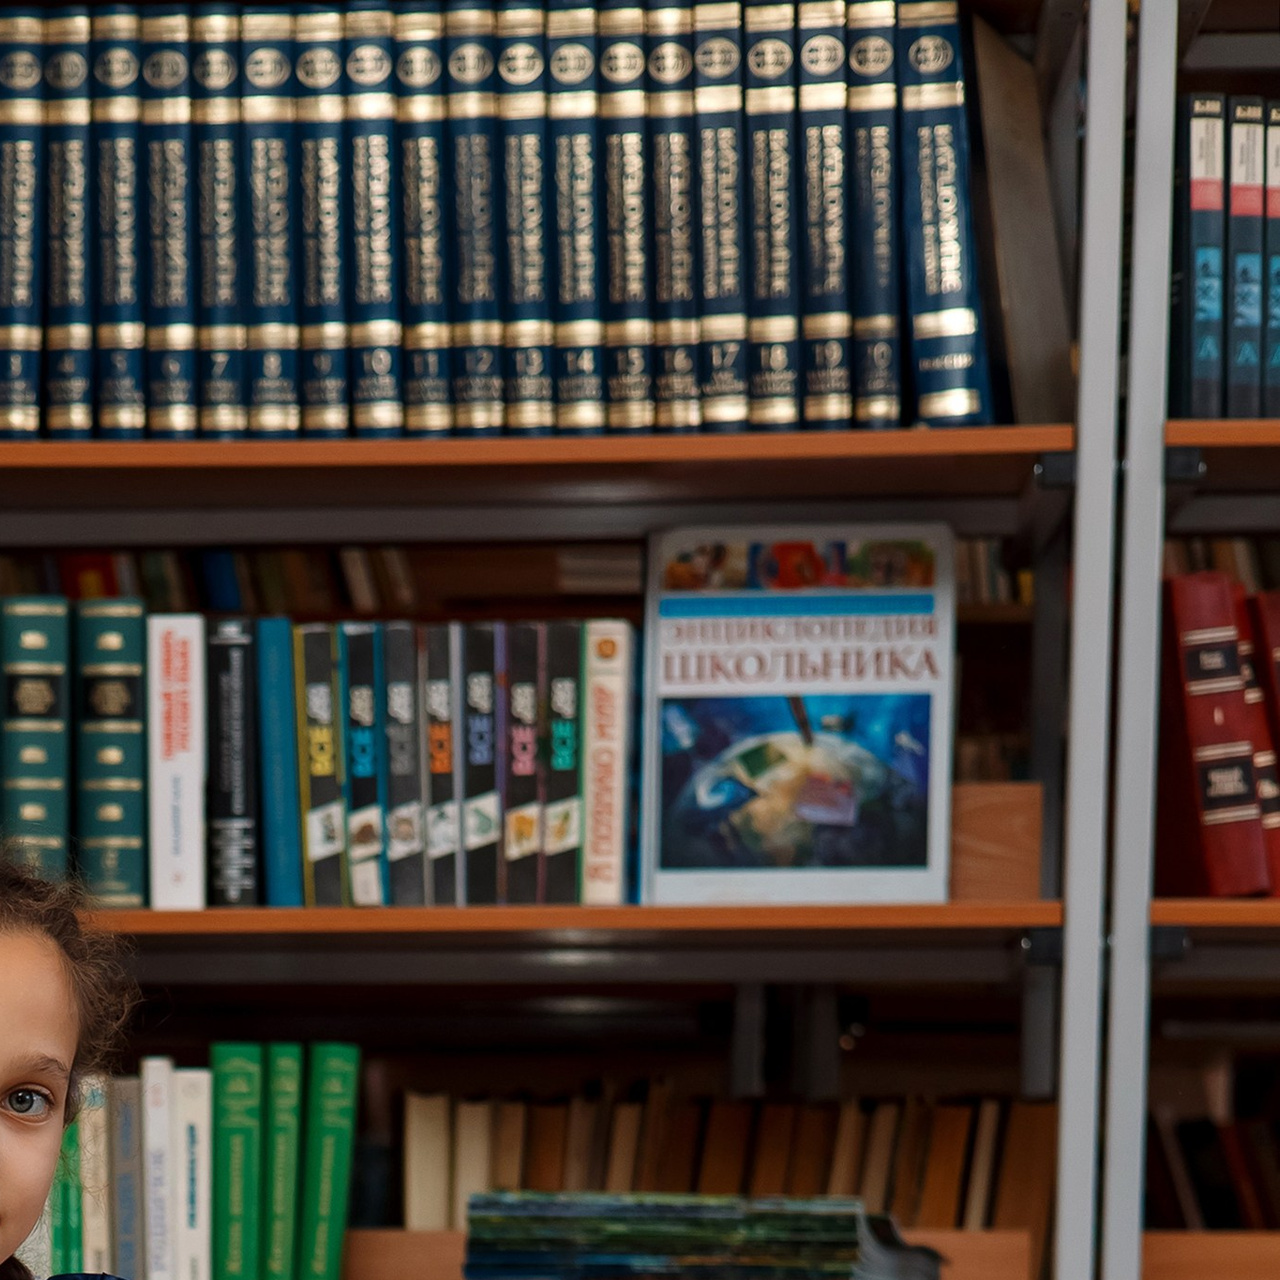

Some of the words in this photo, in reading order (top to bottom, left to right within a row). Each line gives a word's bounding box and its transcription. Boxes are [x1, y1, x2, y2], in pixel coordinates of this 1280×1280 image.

[211, 352, 230, 377] 7
[363, 348, 392, 376] 10
[412, 351, 439, 376] 11
[465, 349, 494, 374] 12
[515, 348, 543, 375] 13
[566, 349, 595, 374] 14
[617, 347, 645, 375] 15
[664, 347, 693, 372] 16
[711, 342, 740, 369] 17
[760, 343, 788, 371] 18
[815, 340, 843, 367] 19
[665, 614, 940, 644] ЭНЦИКЛОПЕДИЯ
[662, 644, 941, 684] ШКОЛЬНИКА
